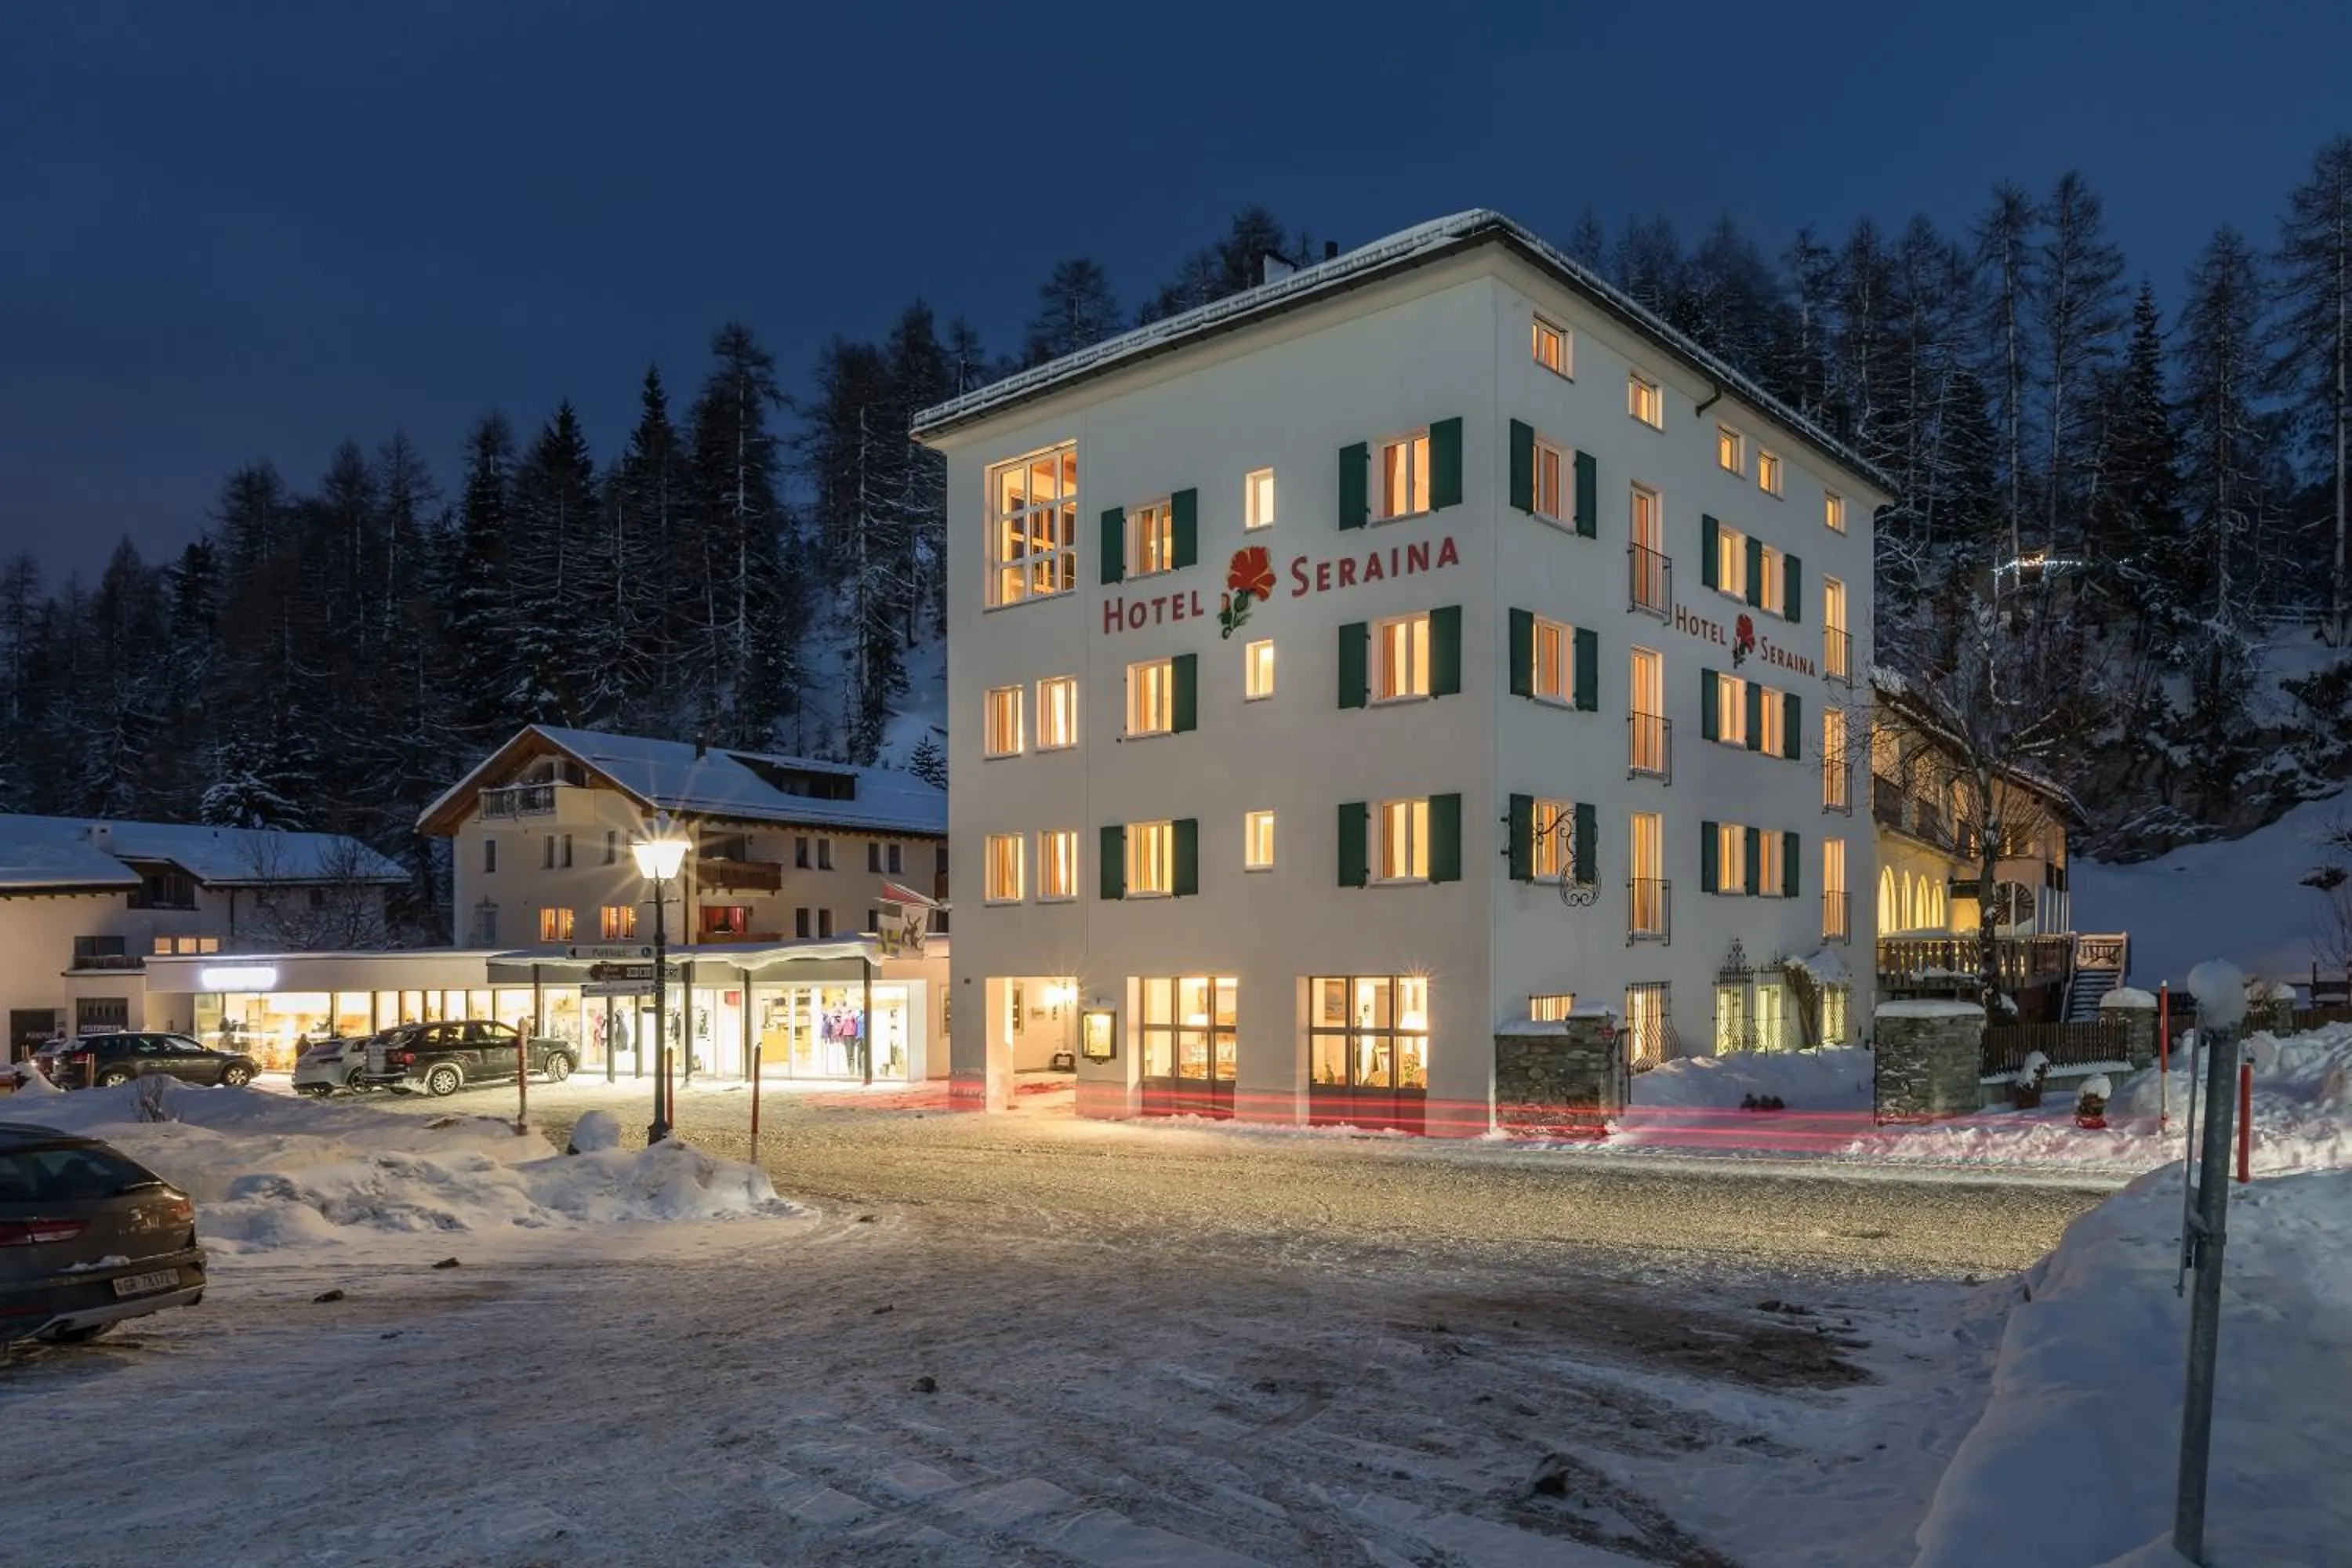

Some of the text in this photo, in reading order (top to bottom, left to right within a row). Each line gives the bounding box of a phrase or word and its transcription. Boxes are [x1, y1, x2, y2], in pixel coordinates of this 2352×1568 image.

[1103, 536, 1459, 633] HOTEL SERAINA
[1675, 603, 1816, 678] HOTEL SERAINA
